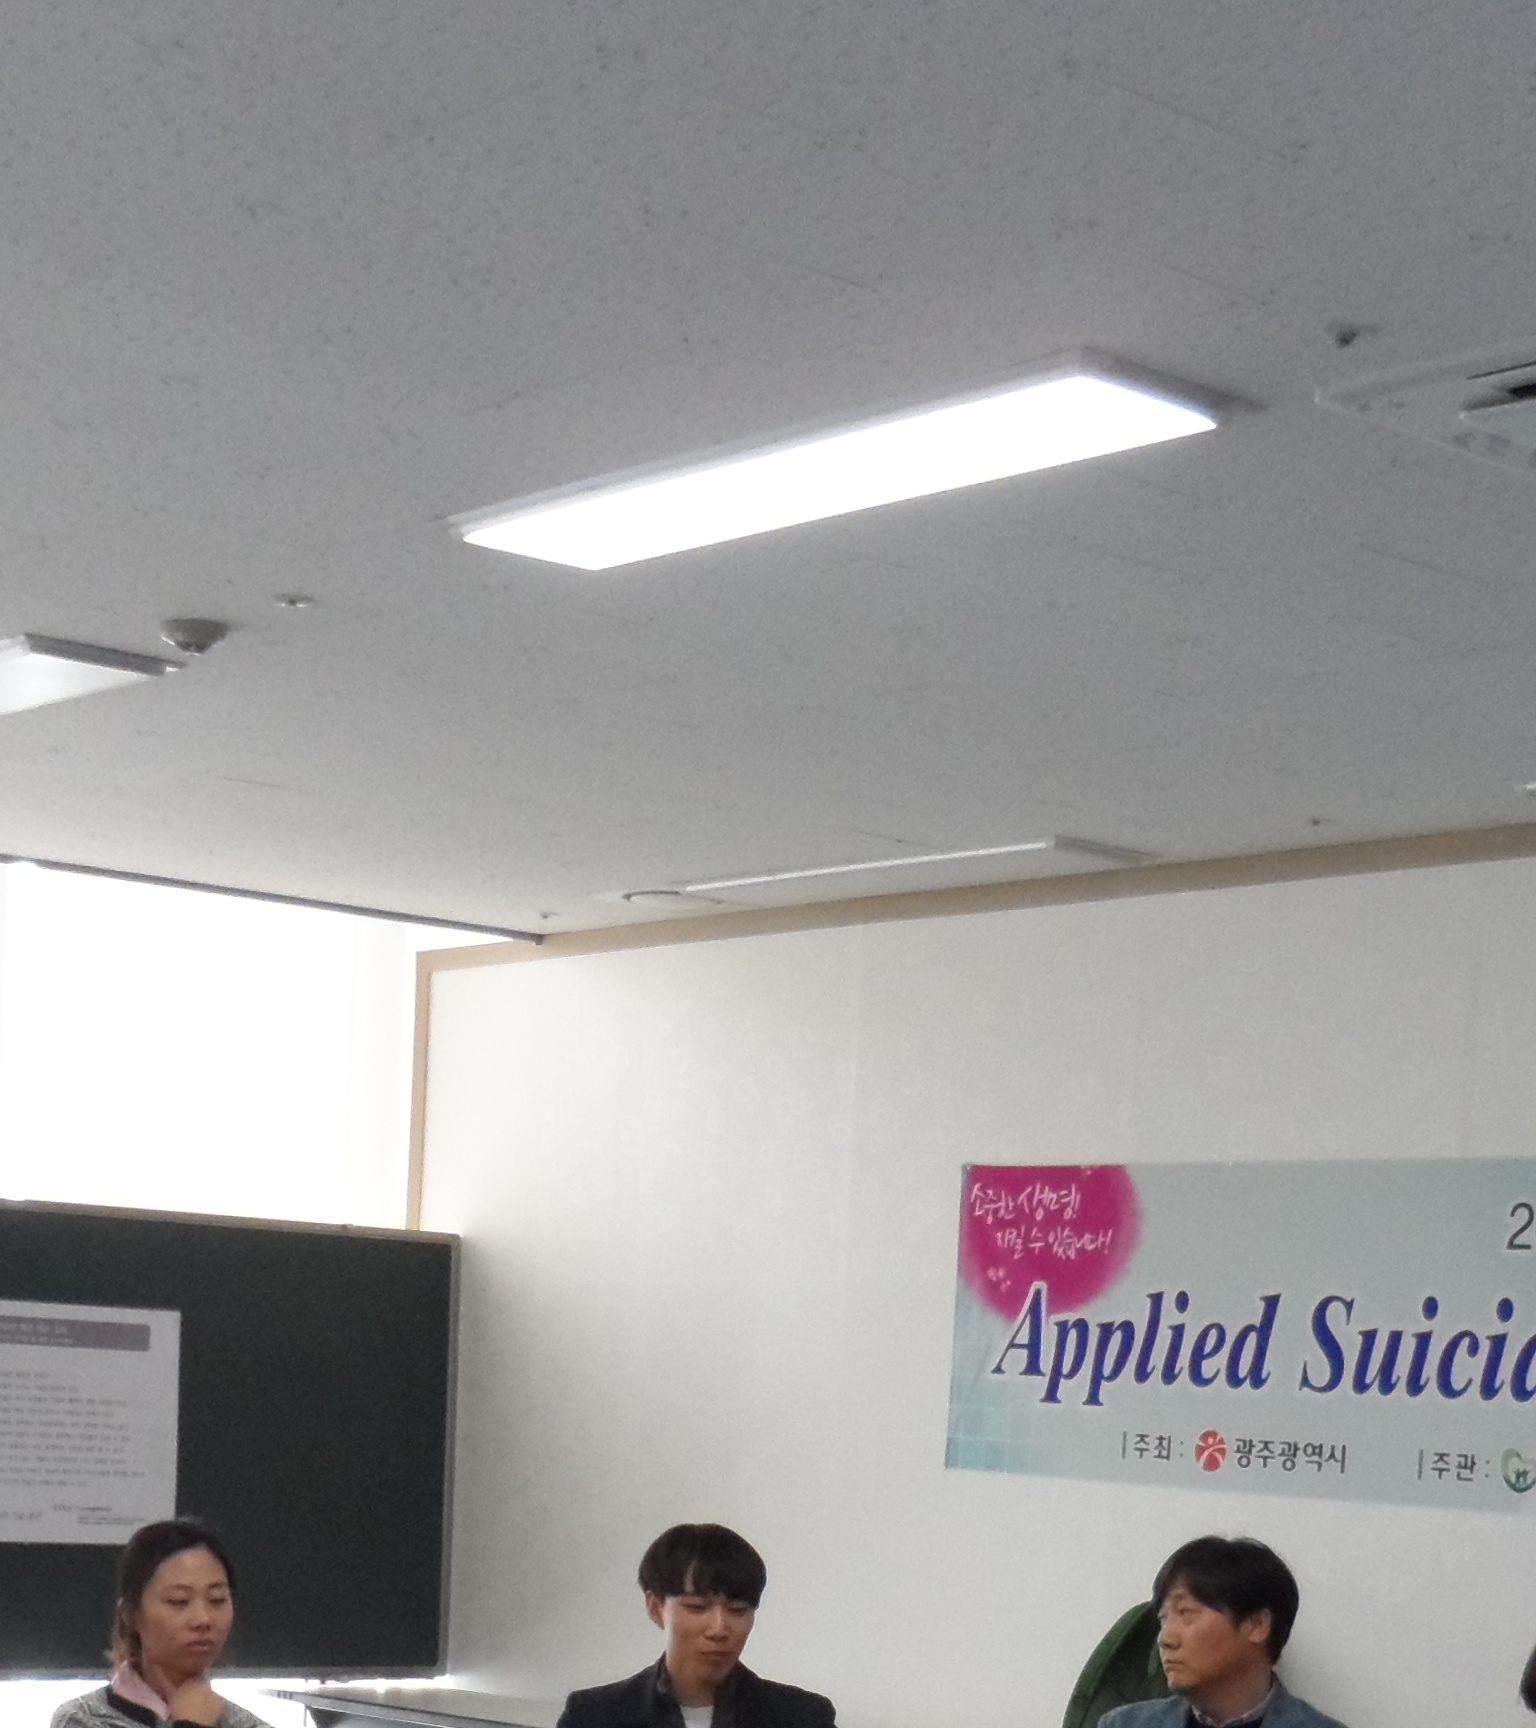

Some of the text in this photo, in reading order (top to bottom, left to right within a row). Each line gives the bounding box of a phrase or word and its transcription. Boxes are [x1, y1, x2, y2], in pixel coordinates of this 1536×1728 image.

[970, 1182, 1081, 1225] 소중한 생명!
[992, 1287, 1282, 1406] Applied
[1233, 1438, 1347, 1474] 광주광역시
